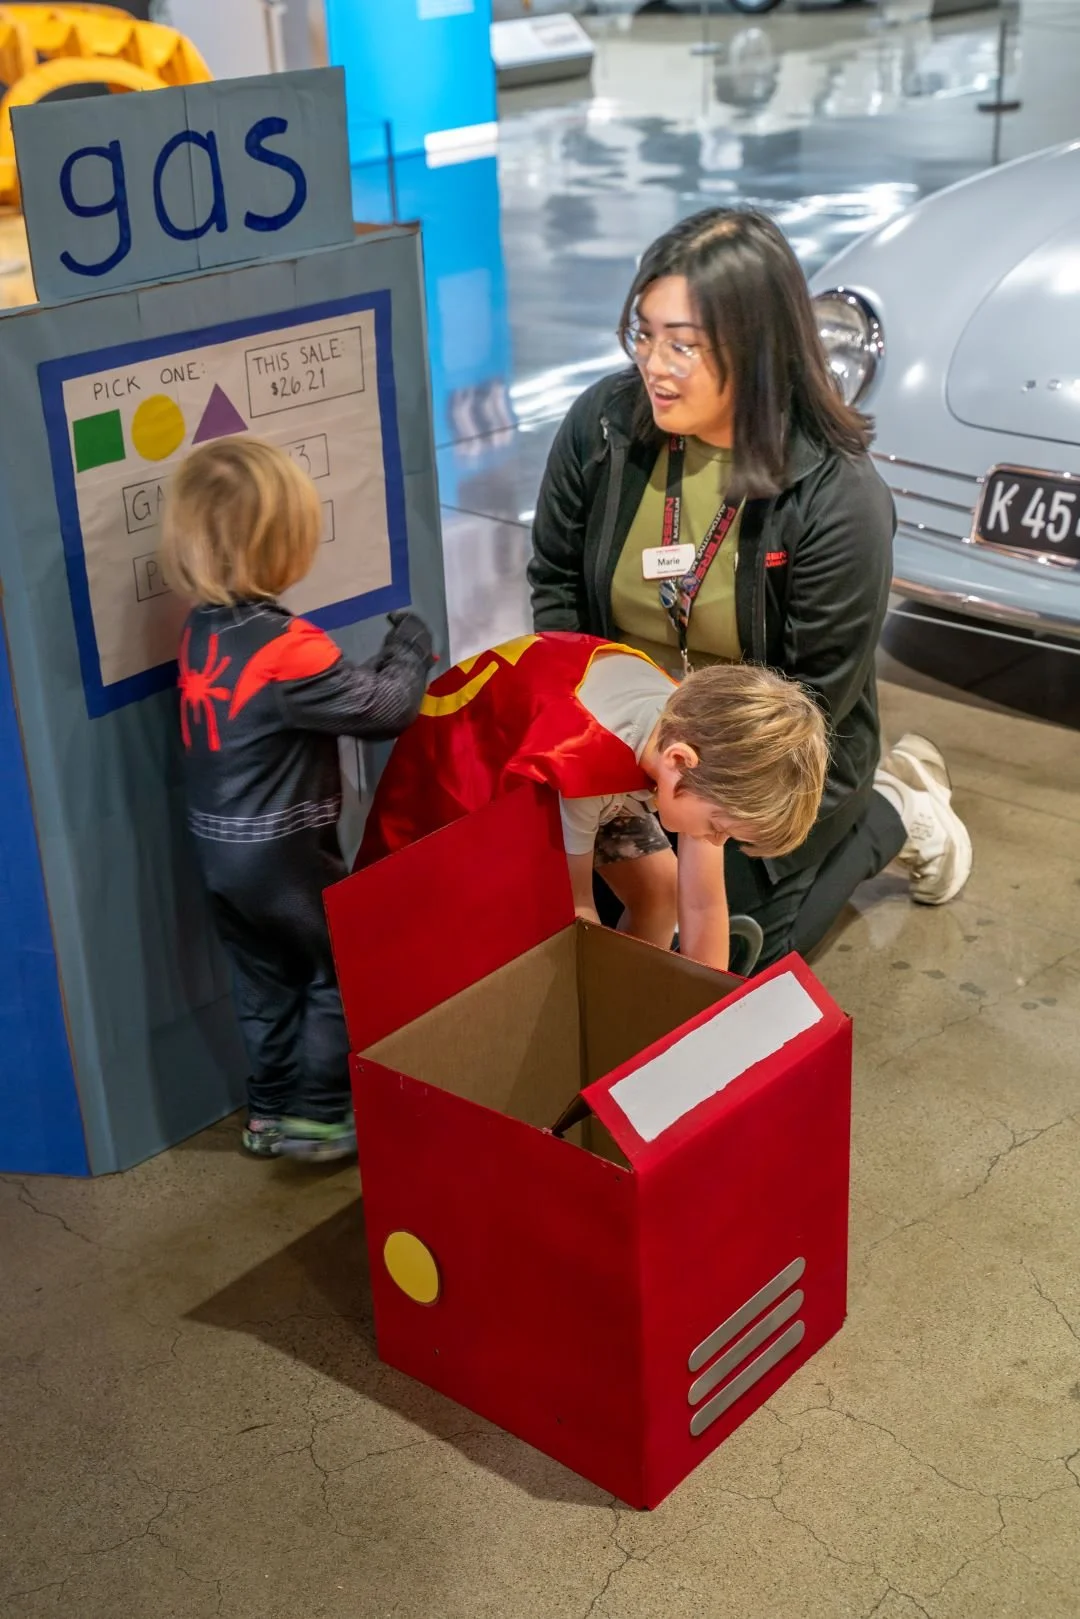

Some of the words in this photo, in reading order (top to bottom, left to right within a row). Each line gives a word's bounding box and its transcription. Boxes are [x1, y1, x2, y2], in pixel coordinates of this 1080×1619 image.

[59, 116, 307, 276] gas
[252, 351, 290, 375] THIS
[299, 338, 345, 365] SALE:
[93, 376, 141, 401] PICK
[160, 361, 206, 385] ONE:
[986, 480, 1020, 533] K
[1020, 486, 1080, 543] 45
[657, 556, 681, 567] Marie
